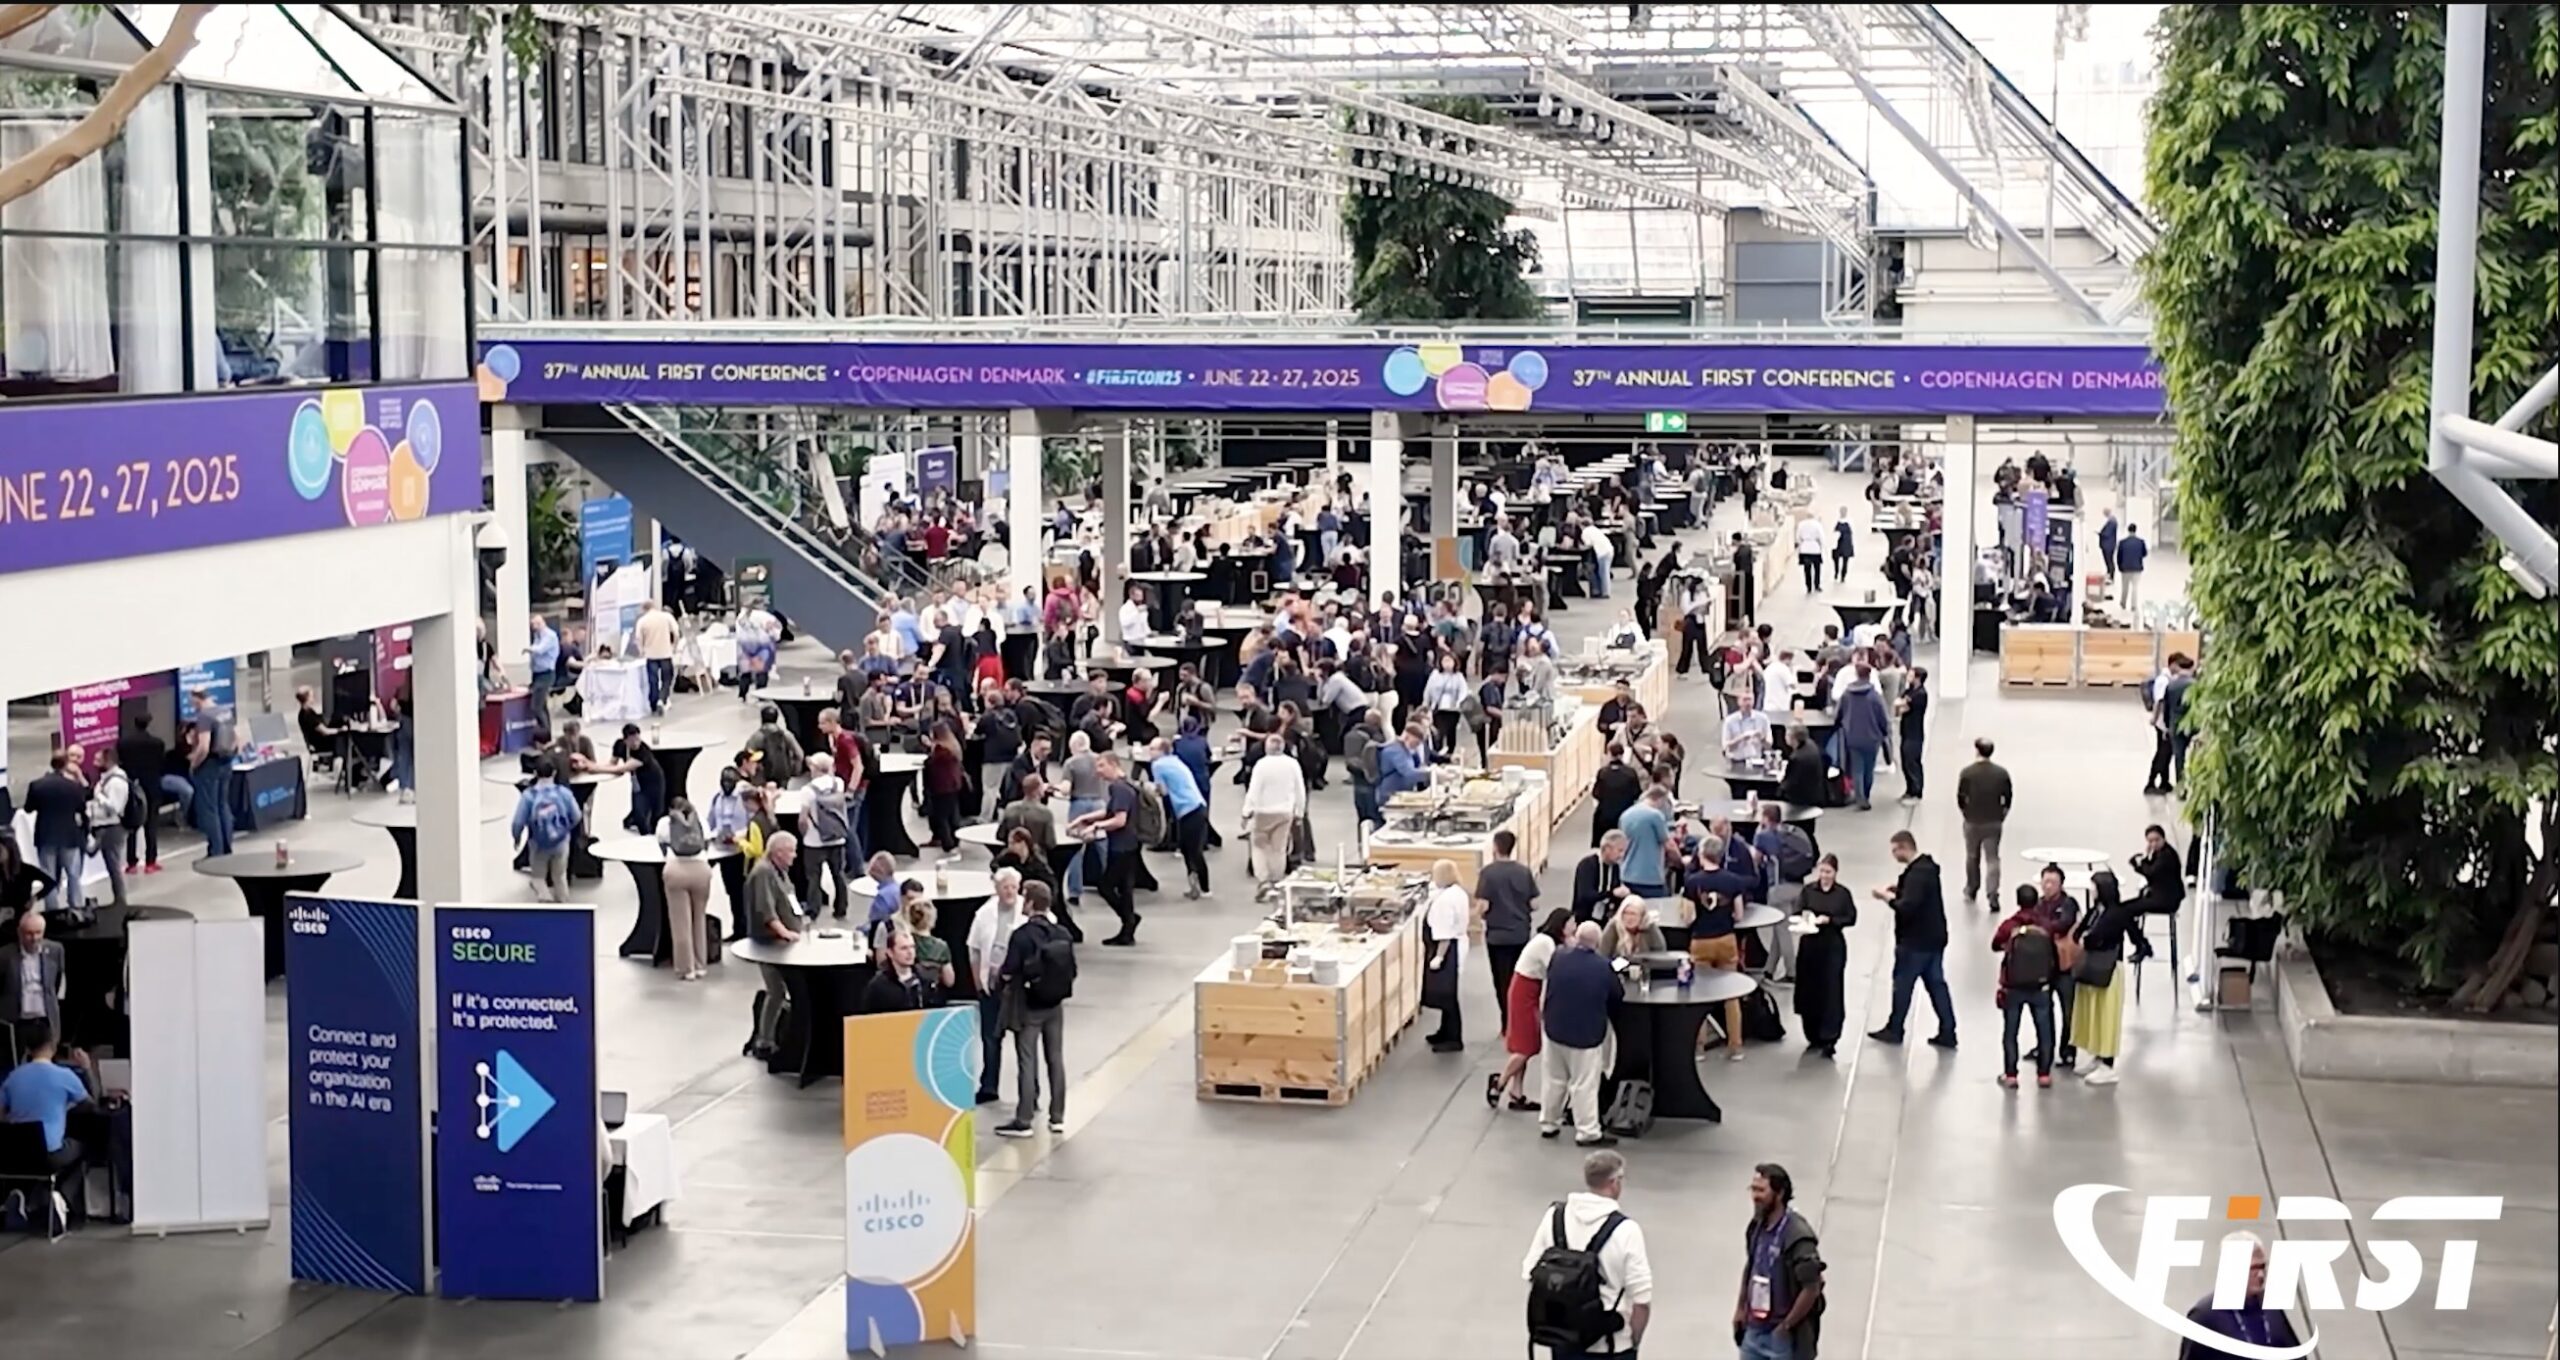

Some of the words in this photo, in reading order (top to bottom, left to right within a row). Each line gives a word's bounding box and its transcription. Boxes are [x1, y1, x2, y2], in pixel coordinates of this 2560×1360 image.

[581, 363, 650, 380] ANNUAL
[657, 364, 705, 380] FIRST
[711, 364, 827, 382] CONFERENCE
[847, 365, 973, 383] COPENHAGEN
[980, 366, 1066, 384] DENMARK
[1201, 369, 1243, 386] JUNE
[1312, 369, 1361, 386] 2025
[1615, 370, 1693, 387] ANNUAL
[1702, 369, 1756, 387] FIRST
[1763, 369, 1895, 388] CONFERENCE
[1920, 370, 2064, 389] COPENHAGEN
[166, 454, 240, 508] 2025
[452, 942, 537, 963] SECURE
[452, 993, 463, 1009] If
[492, 995, 579, 1014] connected,
[479, 1014, 558, 1031] protected.
[308, 1024, 367, 1047] Connect
[370, 1033, 397, 1049] and
[308, 1049, 357, 1067] protect
[361, 1054, 392, 1070] your
[308, 1070, 392, 1090] organization
[308, 1089, 322, 1105] in
[325, 1090, 348, 1108] the
[351, 1092, 365, 1109] AI
[368, 1096, 392, 1112] era
[863, 1213, 924, 1233] CISCO
